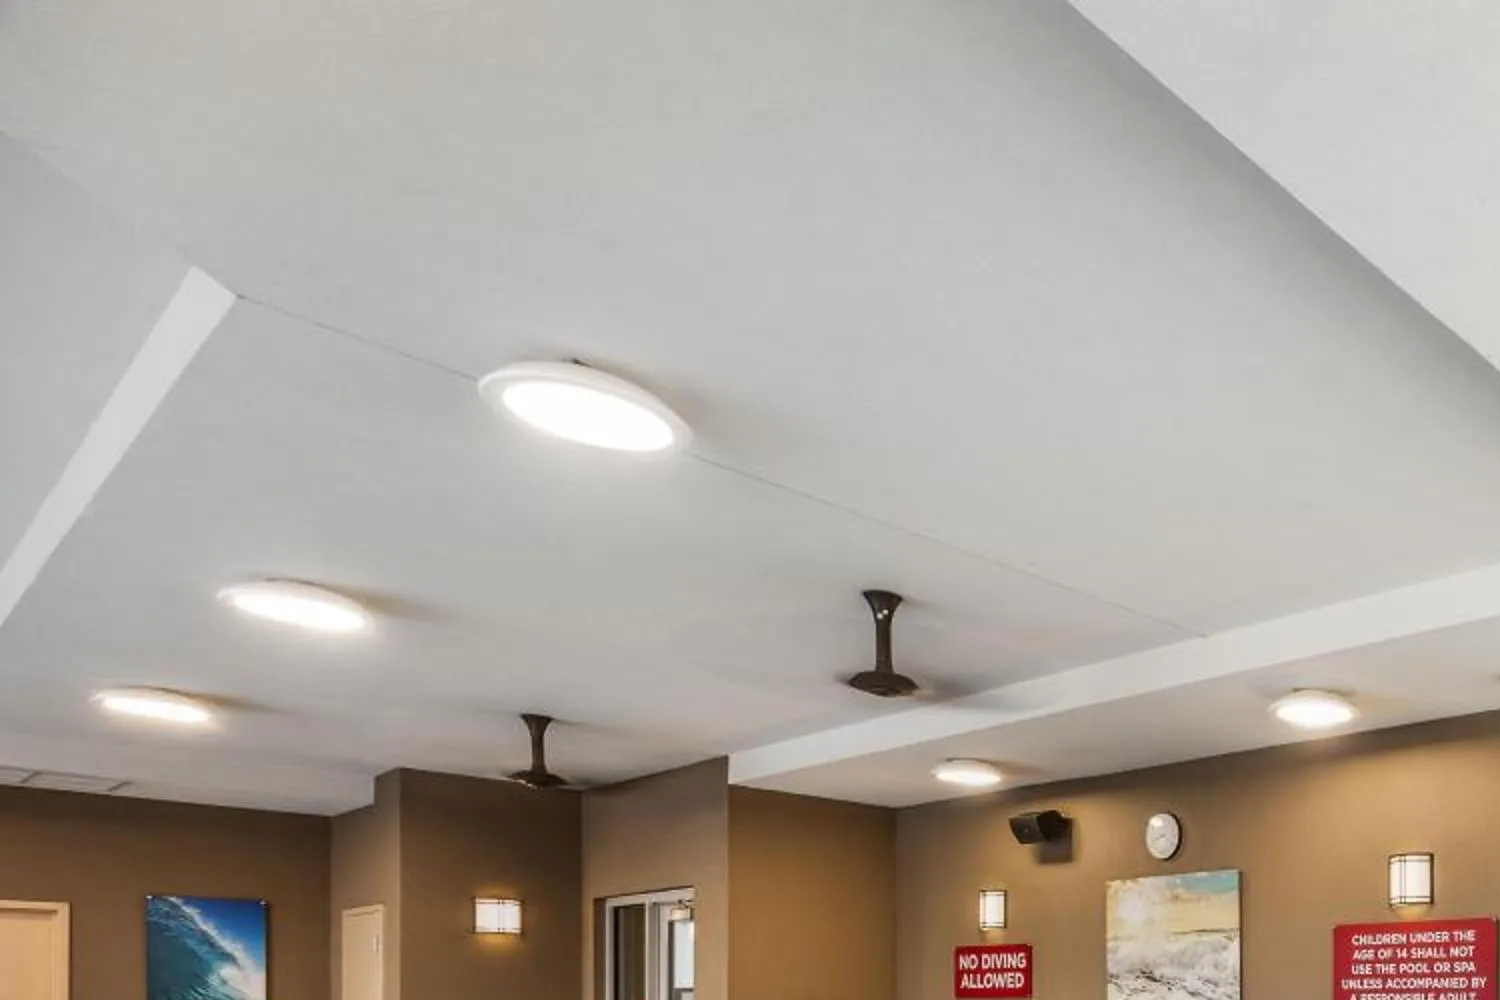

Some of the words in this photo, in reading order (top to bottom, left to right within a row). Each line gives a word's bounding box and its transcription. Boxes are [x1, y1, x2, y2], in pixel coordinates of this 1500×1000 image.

[1351, 933, 1407, 945] CHILDREN
[1409, 931, 1450, 943] UNDER
[1453, 930, 1476, 941] THE
[1353, 949, 1376, 960] AGE
[1377, 948, 1393, 960] OF
[1396, 948, 1408, 959] 14
[1411, 947, 1446, 958] SHALL
[1449, 946, 1475, 957] NOT
[960, 953, 979, 970] NO
[981, 952, 1027, 969] DIVING
[1351, 963, 1373, 975] USE
[1375, 963, 1397, 974] THE
[1400, 962, 1431, 973] POOL
[1433, 962, 1451, 973] OR
[1453, 961, 1476, 972] SPA
[960, 972, 1025, 989] ALLOWED
[1341, 979, 1383, 990] UNLESS
[1385, 977, 1468, 989] ACCOMPANIED
[1471, 977, 1487, 989] BY
